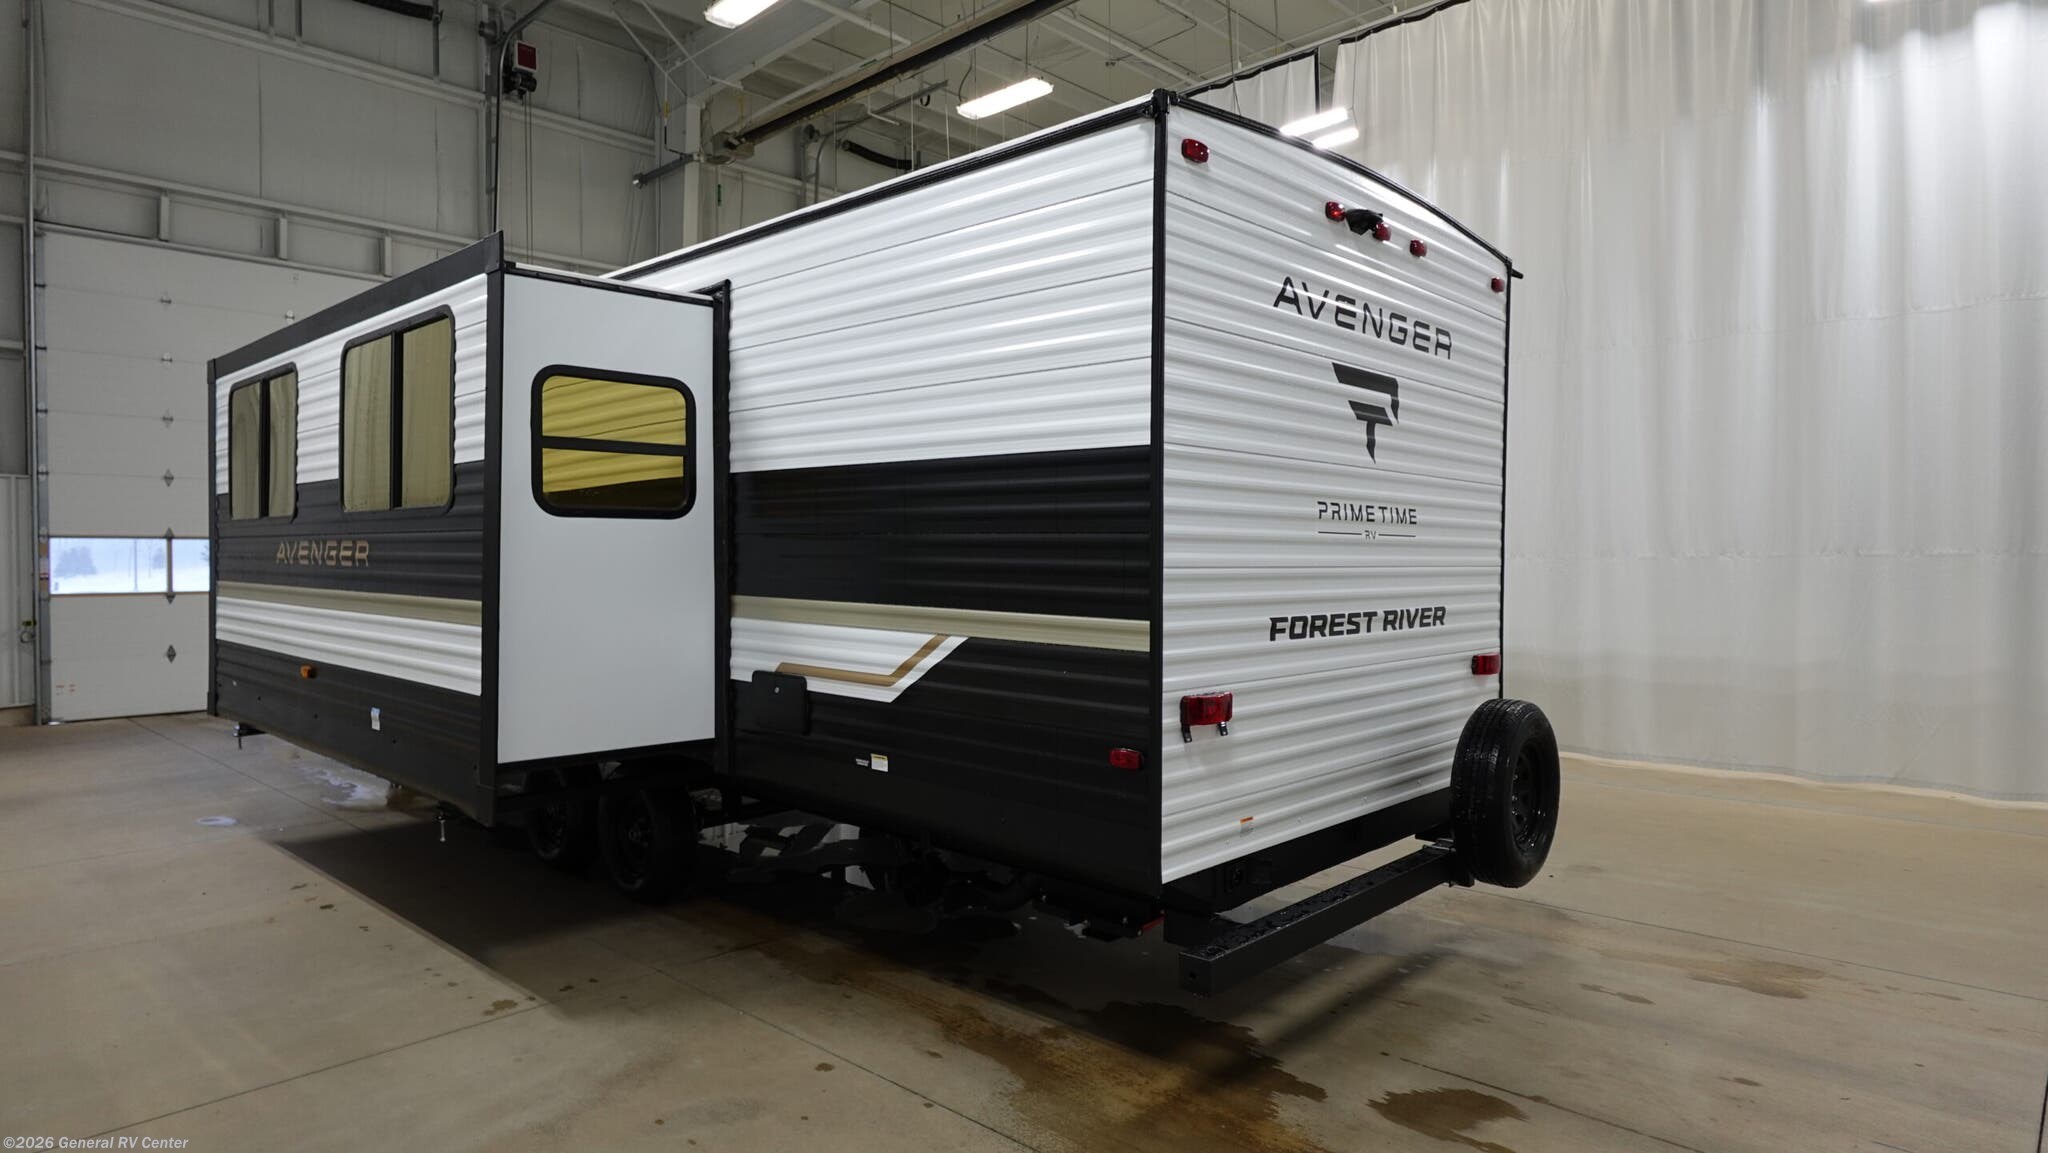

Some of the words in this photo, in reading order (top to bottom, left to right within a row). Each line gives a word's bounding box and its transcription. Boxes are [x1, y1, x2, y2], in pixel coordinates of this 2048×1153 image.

[1273, 276, 1453, 360] AVENGER
[1364, 530, 1377, 540] RV
[275, 540, 370, 567] AVENGER
[1269, 611, 1378, 642] FOREST
[1382, 606, 1447, 631] RIVER
